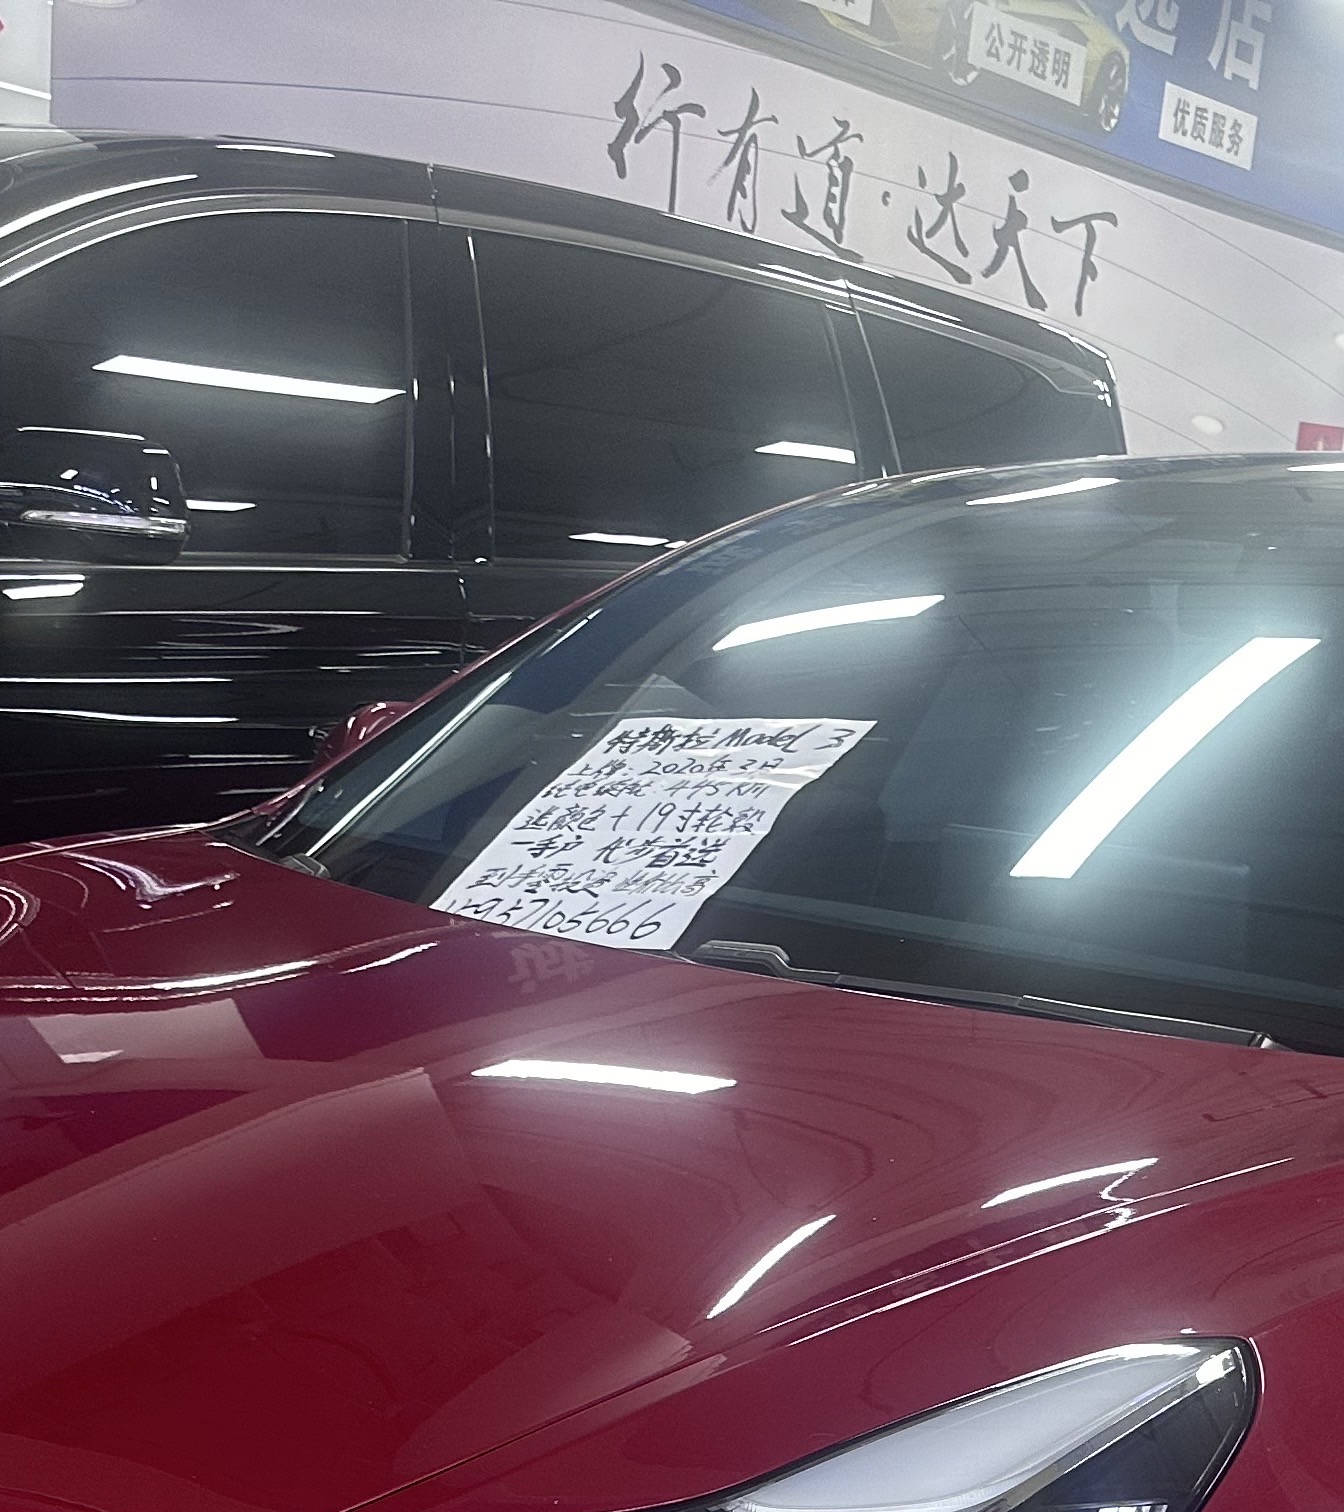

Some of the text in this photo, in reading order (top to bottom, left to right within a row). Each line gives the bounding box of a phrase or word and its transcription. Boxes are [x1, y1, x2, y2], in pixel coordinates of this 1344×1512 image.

[984, 22, 1072, 90] 公开透明
[1172, 96, 1244, 157] 优质服务
[602, 723, 857, 756] 特斯拉 Model 3
